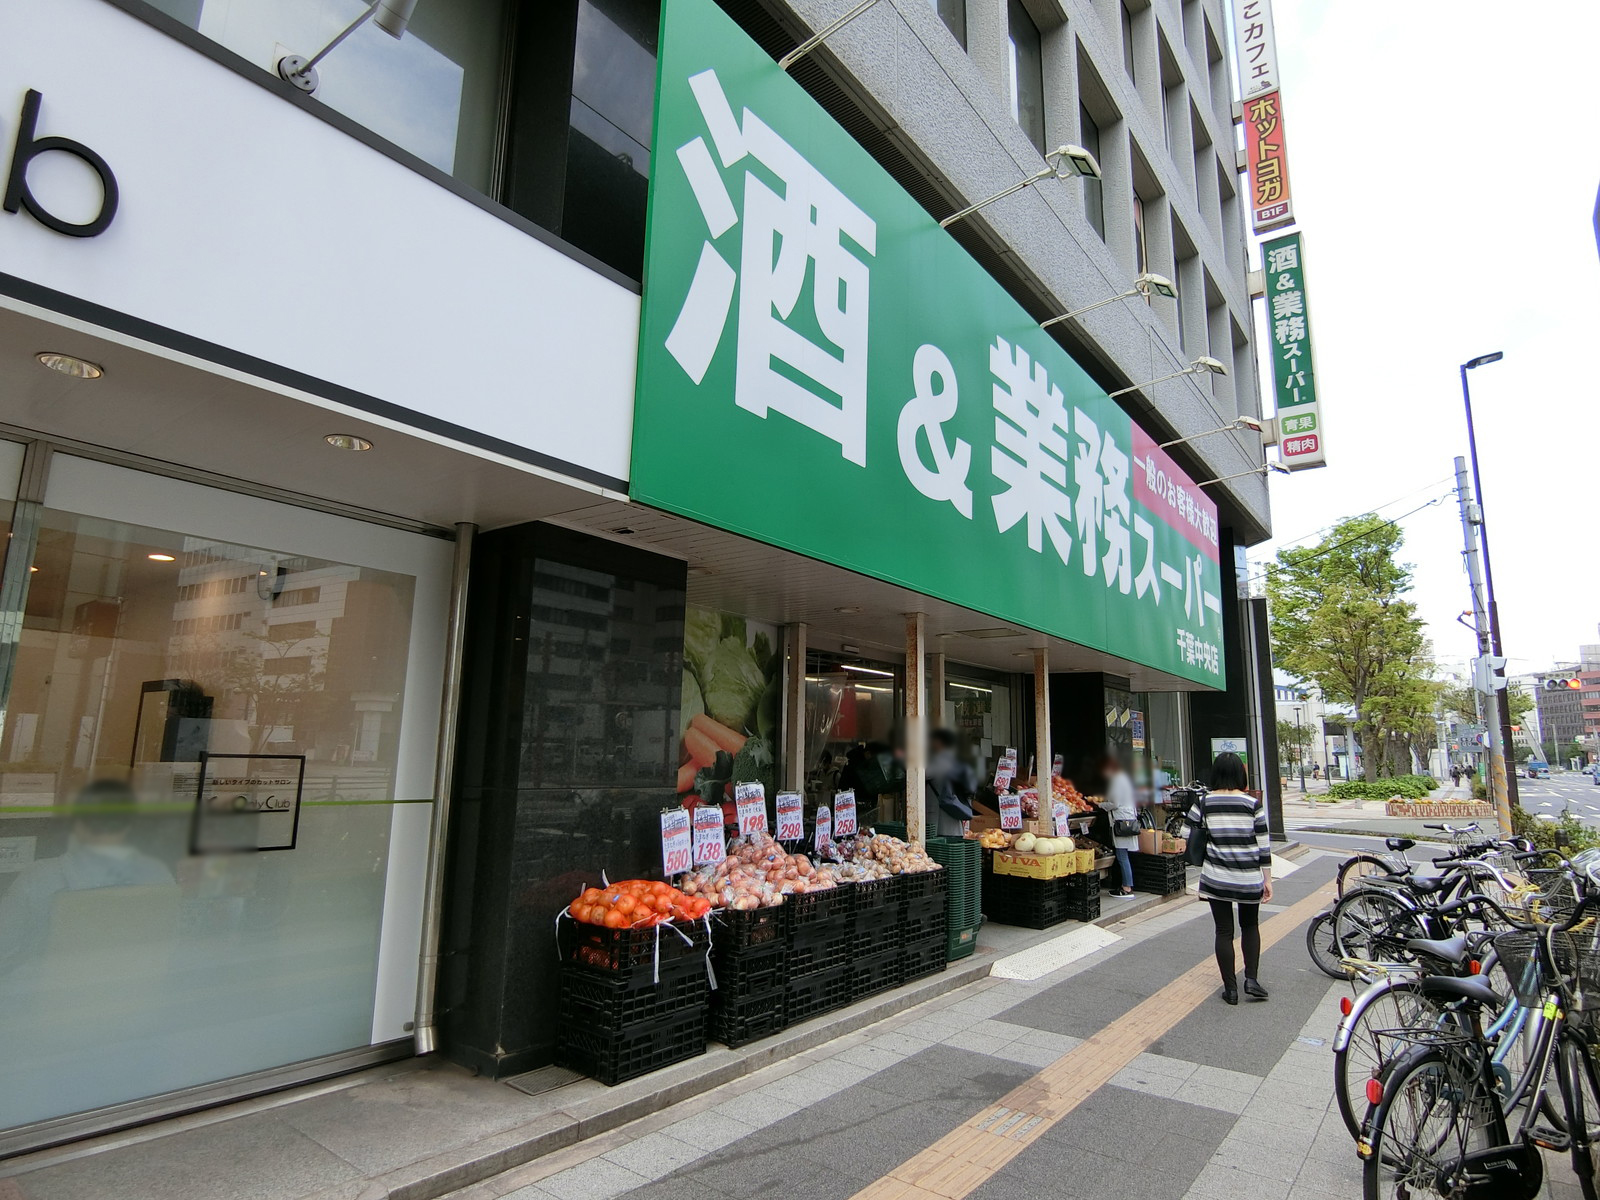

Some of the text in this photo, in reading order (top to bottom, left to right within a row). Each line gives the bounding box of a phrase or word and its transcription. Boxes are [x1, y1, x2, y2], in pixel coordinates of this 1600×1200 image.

[1249, 97, 1283, 206] ホットヨガ
[1261, 205, 1284, 220] B1F
[1284, 416, 1314, 433] 青果
[1286, 437, 1317, 454] 精肉
[1133, 454, 1219, 548] 一般のお客様大歓迎
[1175, 628, 1220, 677] 千葉中央店
[265, 795, 291, 810] Club
[742, 813, 765, 835] 198
[835, 818, 855, 835] 258
[1002, 816, 1020, 828] 398
[778, 822, 801, 840] 298
[696, 842, 722, 861] 138
[665, 847, 689, 874] 580
[998, 854, 1042, 868] VIVA
